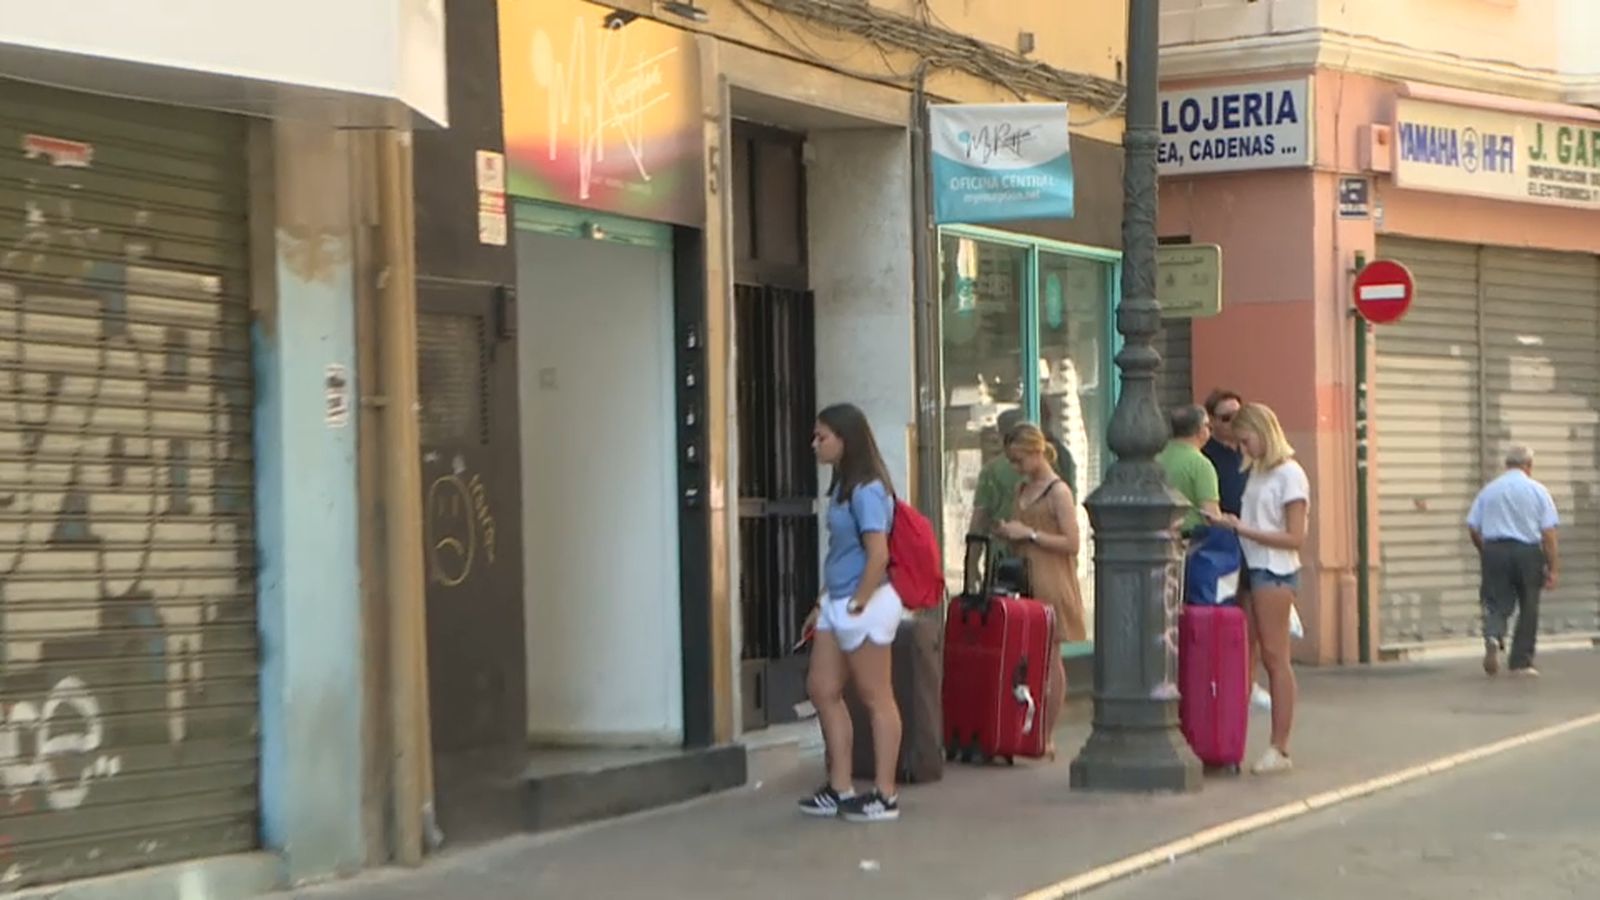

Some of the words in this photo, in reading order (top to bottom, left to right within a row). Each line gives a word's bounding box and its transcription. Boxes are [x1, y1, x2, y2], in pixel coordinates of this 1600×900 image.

[1161, 90, 1297, 134] LOJERIA
[1190, 134, 1275, 160] CADENAS
[1399, 121, 1460, 168] YAMAHA
[1528, 122, 1547, 161] J.
[950, 176, 999, 191] OFICINA
[1001, 174, 1056, 189] CENTRAL
